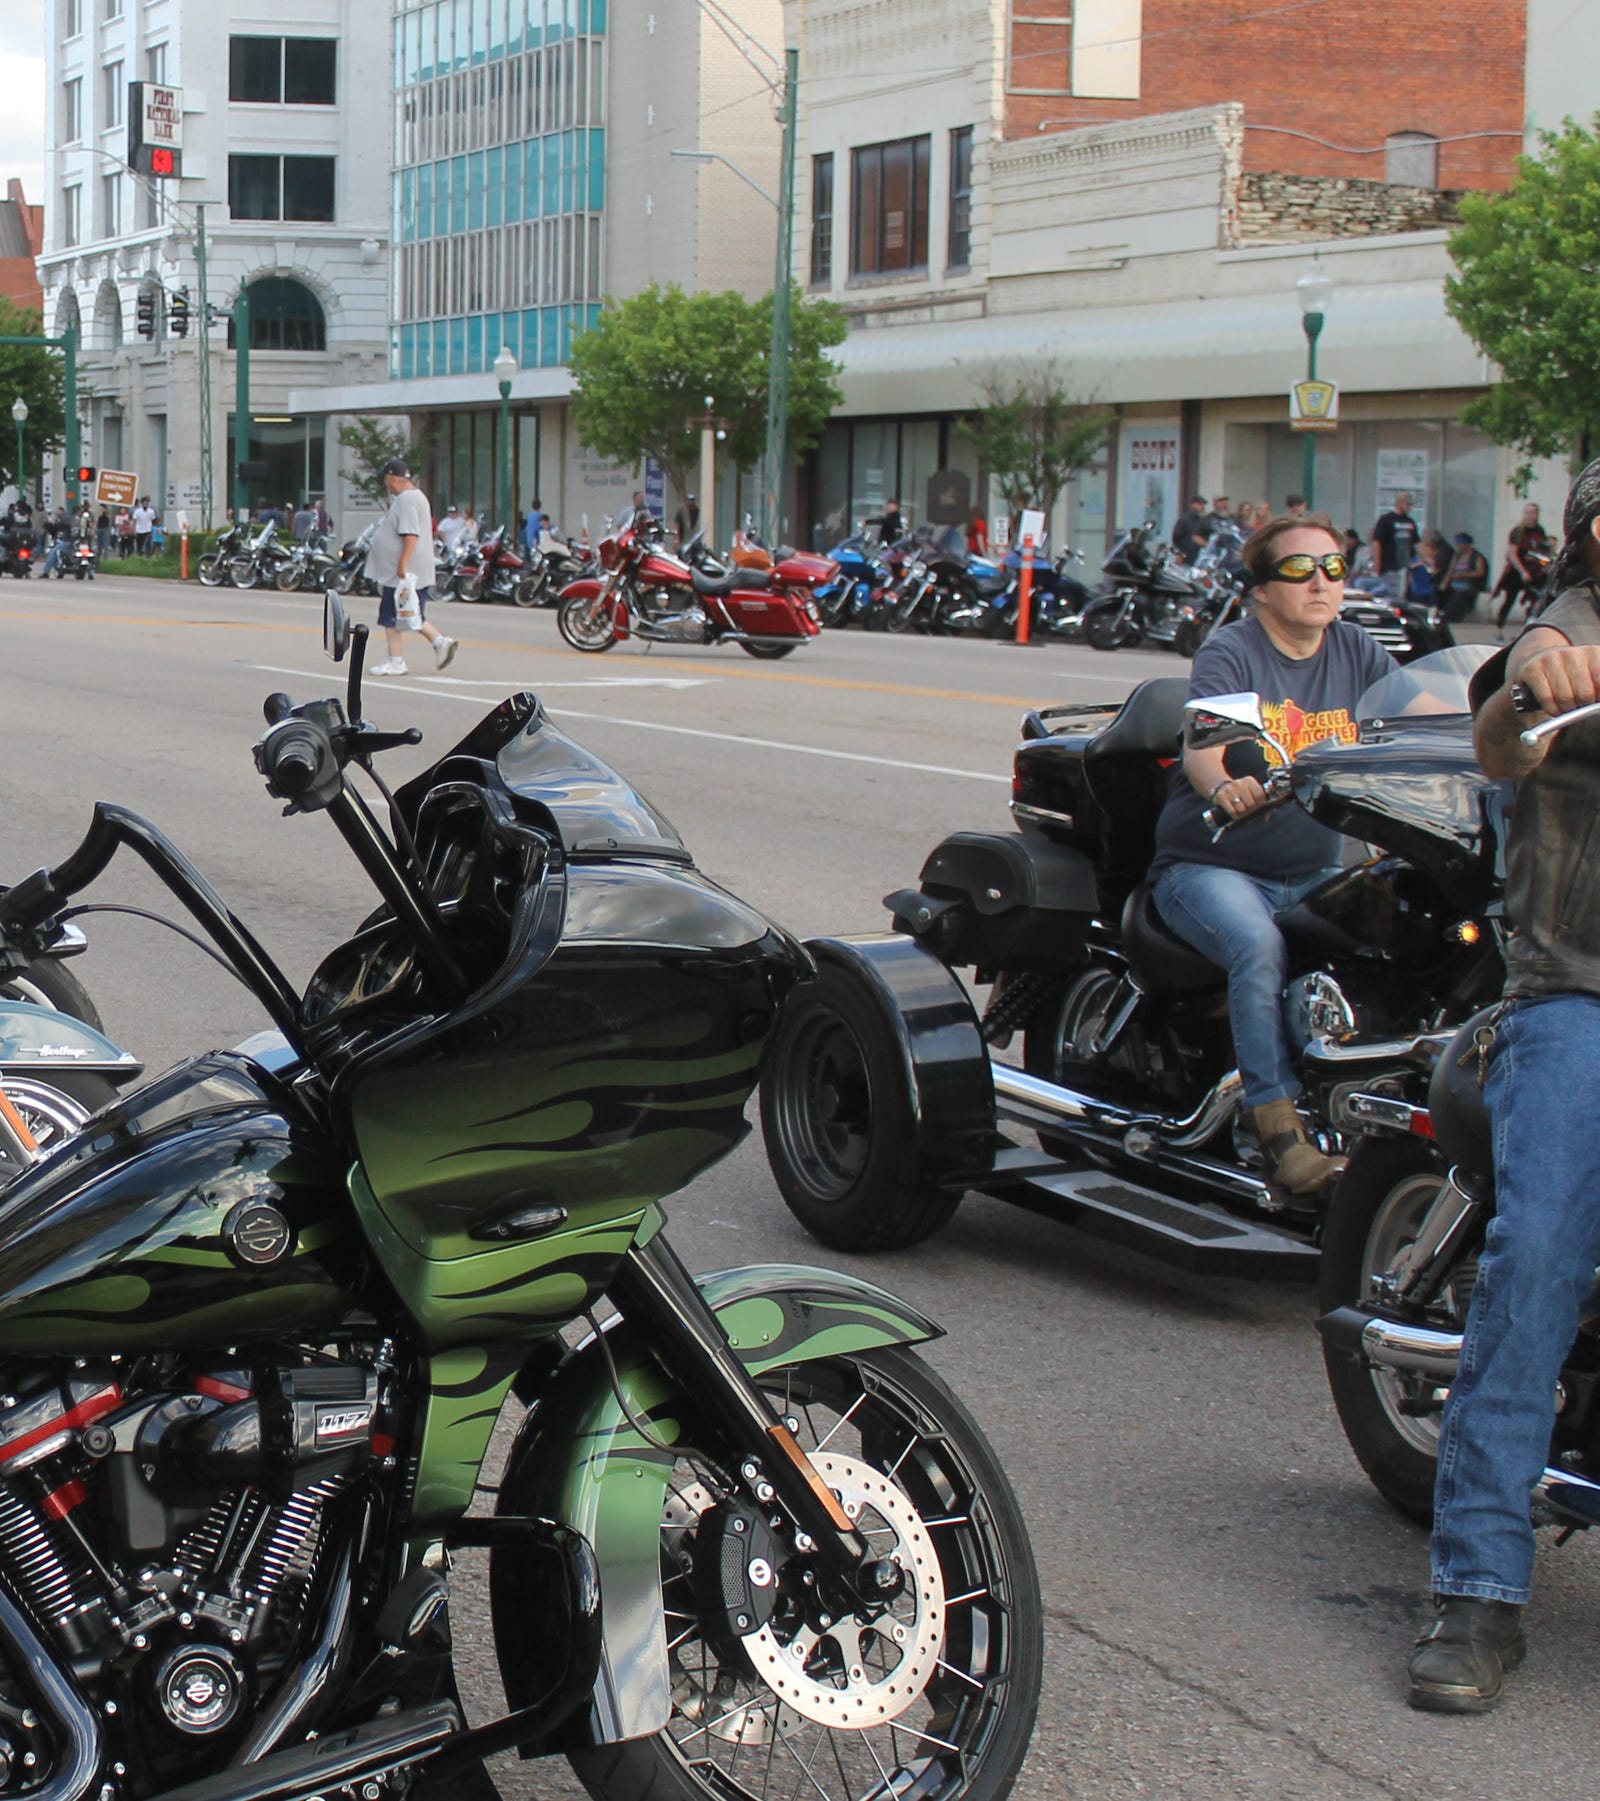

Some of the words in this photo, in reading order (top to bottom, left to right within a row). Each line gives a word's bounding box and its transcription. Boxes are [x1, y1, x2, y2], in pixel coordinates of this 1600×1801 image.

[154, 89, 174, 106] FIRST
[147, 105, 180, 123] NATIONAL
[1131, 440, 1176, 470] BOOTS
[1305, 708, 1348, 729] GELES
[1302, 723, 1357, 744] NGELES
[320, 1410, 368, 1431] 117
